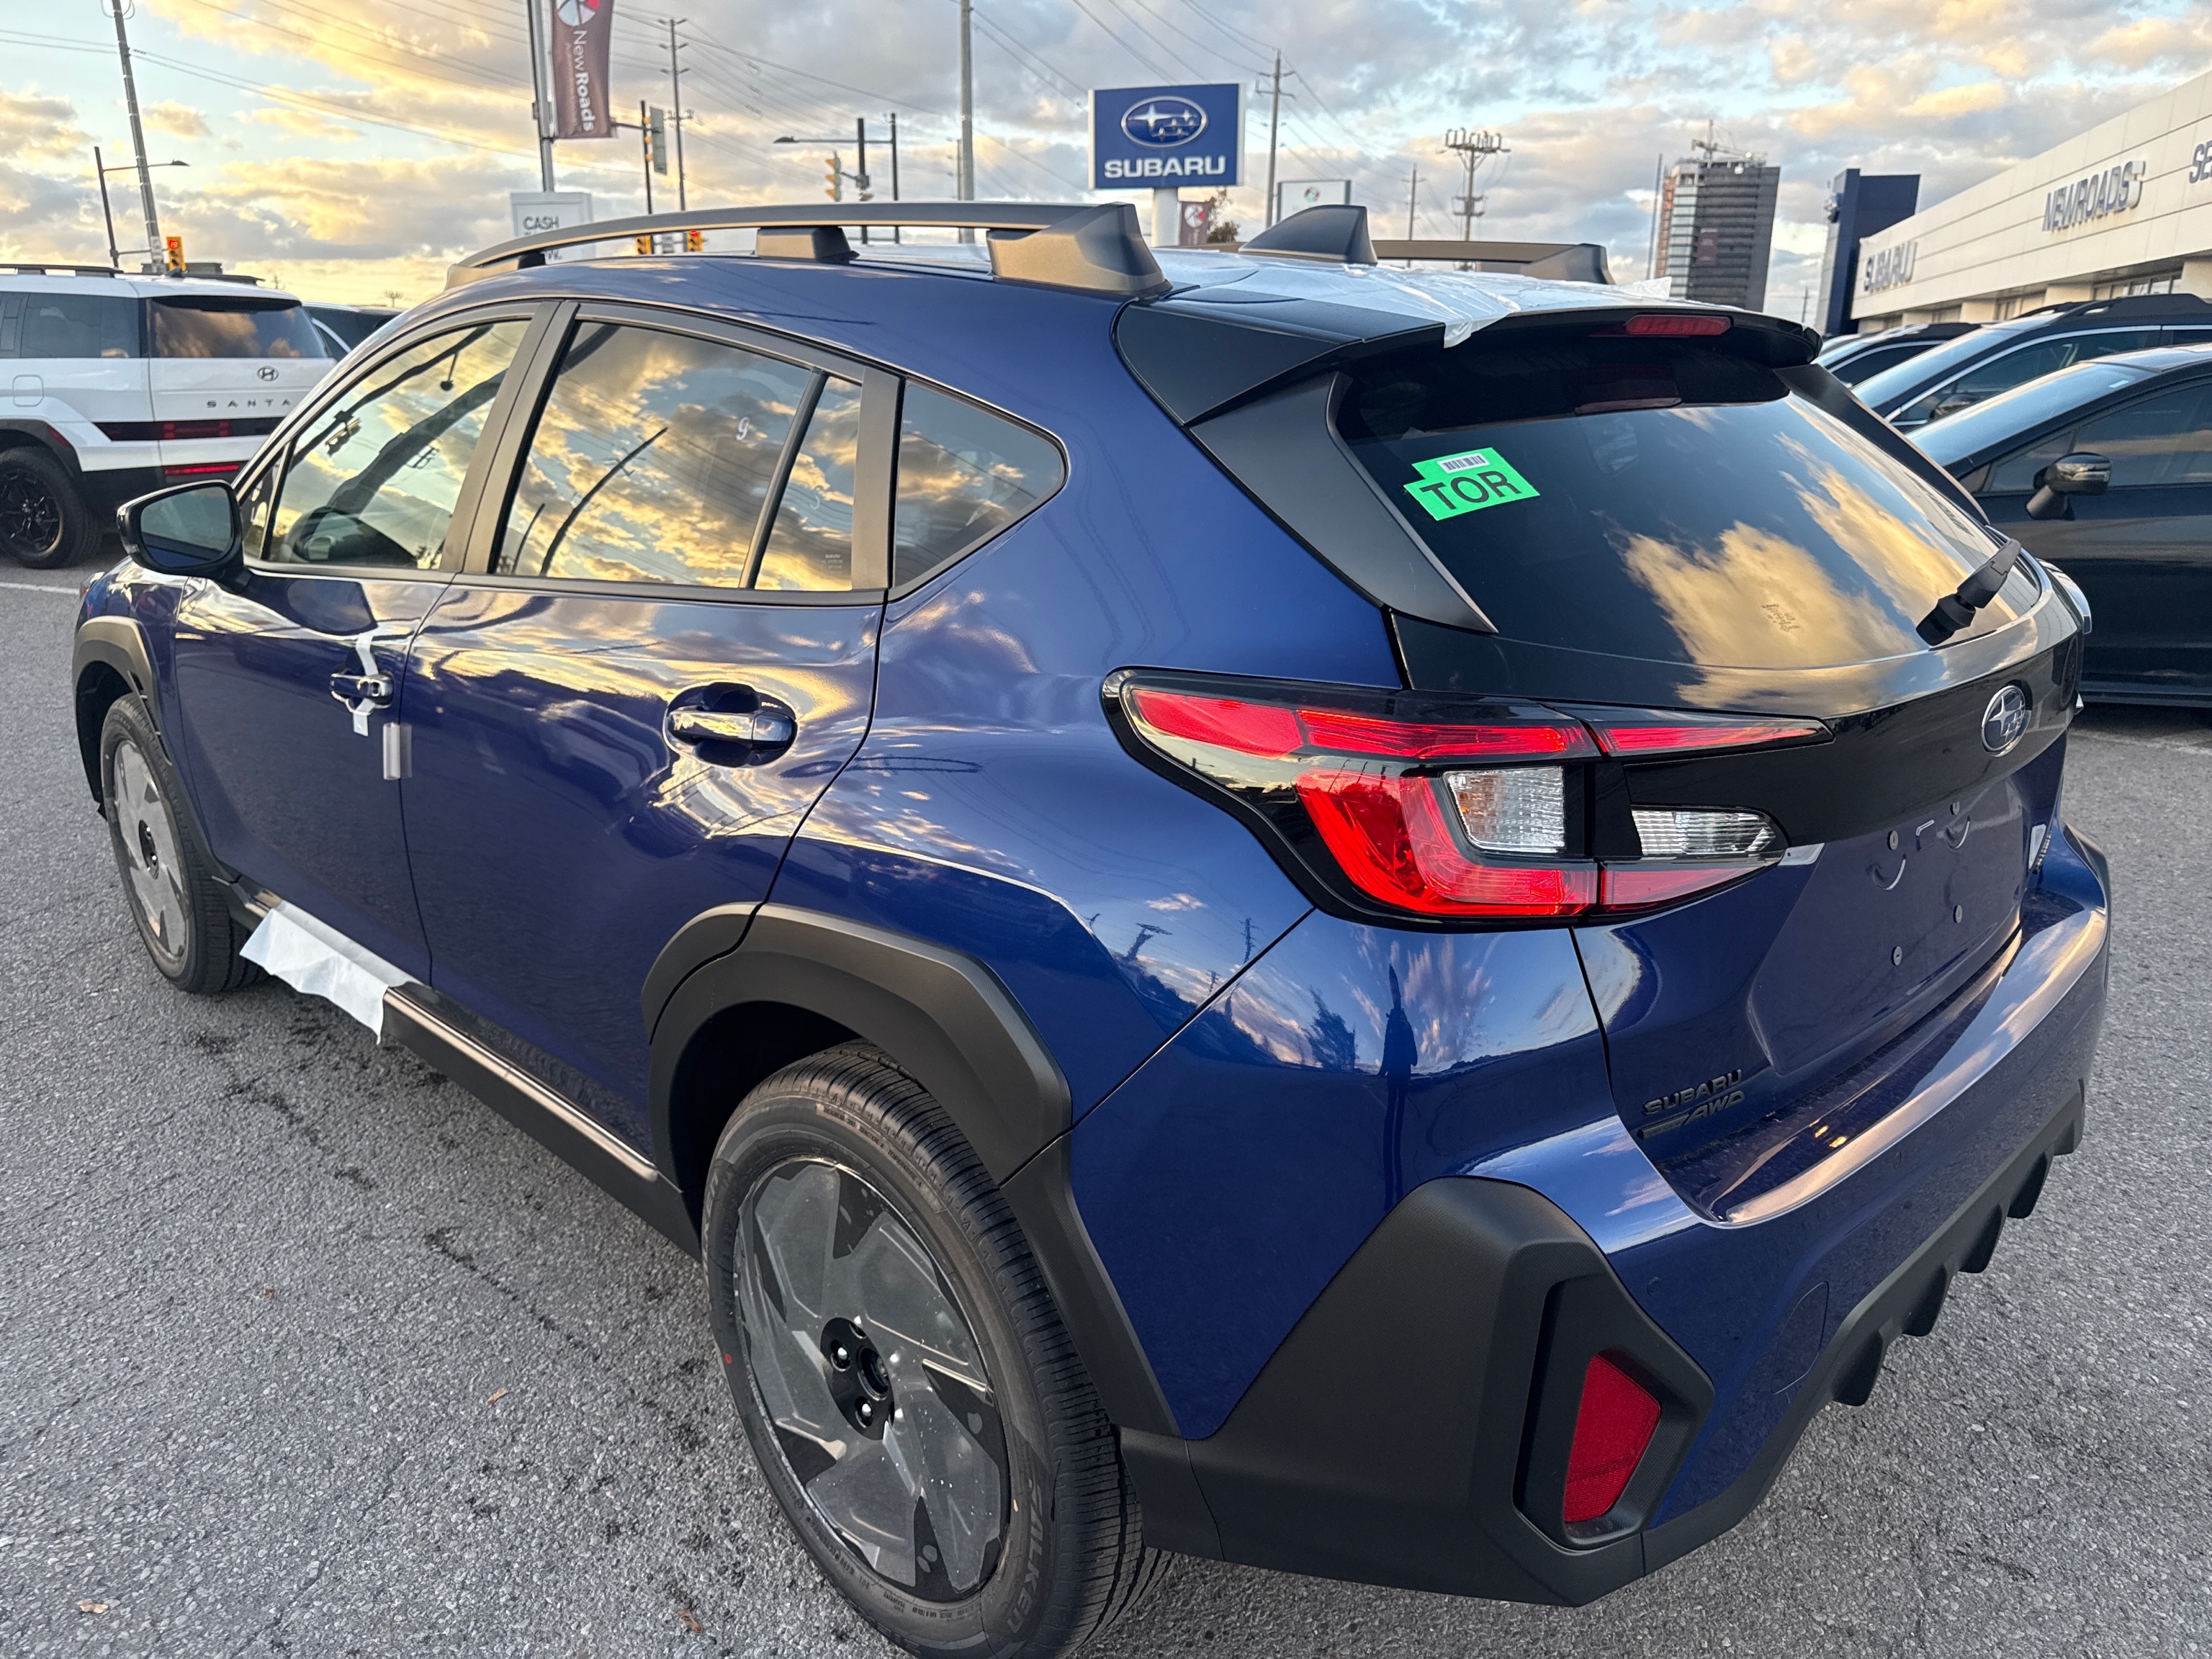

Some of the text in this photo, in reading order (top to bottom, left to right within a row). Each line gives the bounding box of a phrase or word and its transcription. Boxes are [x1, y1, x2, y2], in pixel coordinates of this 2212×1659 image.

[573, 30, 596, 132] NewRoads
[1104, 155, 1226, 179] SUBARU
[2042, 161, 2146, 231] NEWROADS
[523, 215, 559, 230] CASH
[206, 398, 292, 408] SANTA
[1419, 470, 1522, 511] TOR
[1641, 1069, 1742, 1115] SUBARU
[1683, 1090, 1745, 1125] AWD
[1007, 1475, 1043, 1634] FALKEN
